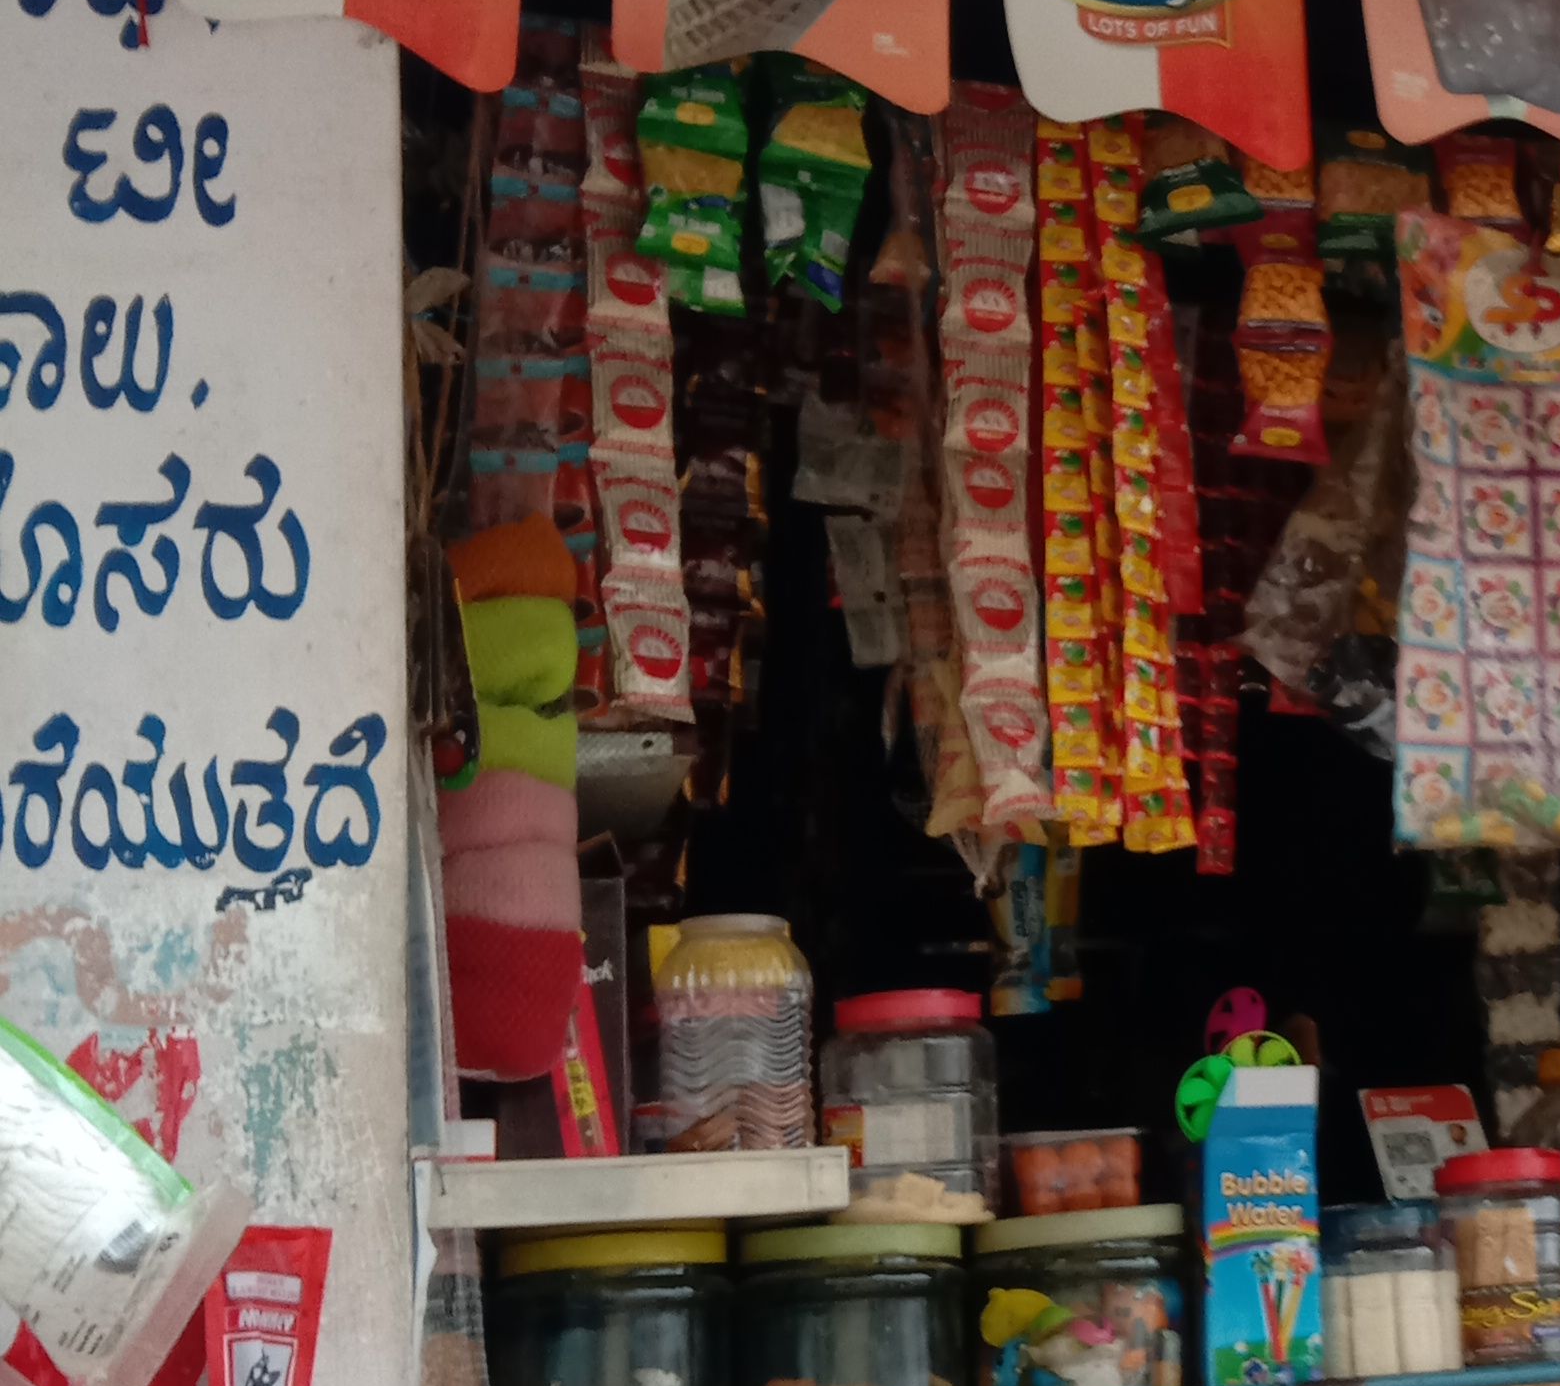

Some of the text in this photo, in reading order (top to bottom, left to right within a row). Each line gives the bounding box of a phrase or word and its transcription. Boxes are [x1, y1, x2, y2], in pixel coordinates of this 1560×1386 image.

[1087, 13, 1218, 40] LOTS OF FUN
[0, 449, 311, 633] ೊಸರು
[0, 707, 387, 912] ರೆಯುತ್ತದೆ
[1220, 1169, 1310, 1198] Bubble
[1226, 1200, 1304, 1227] Water
